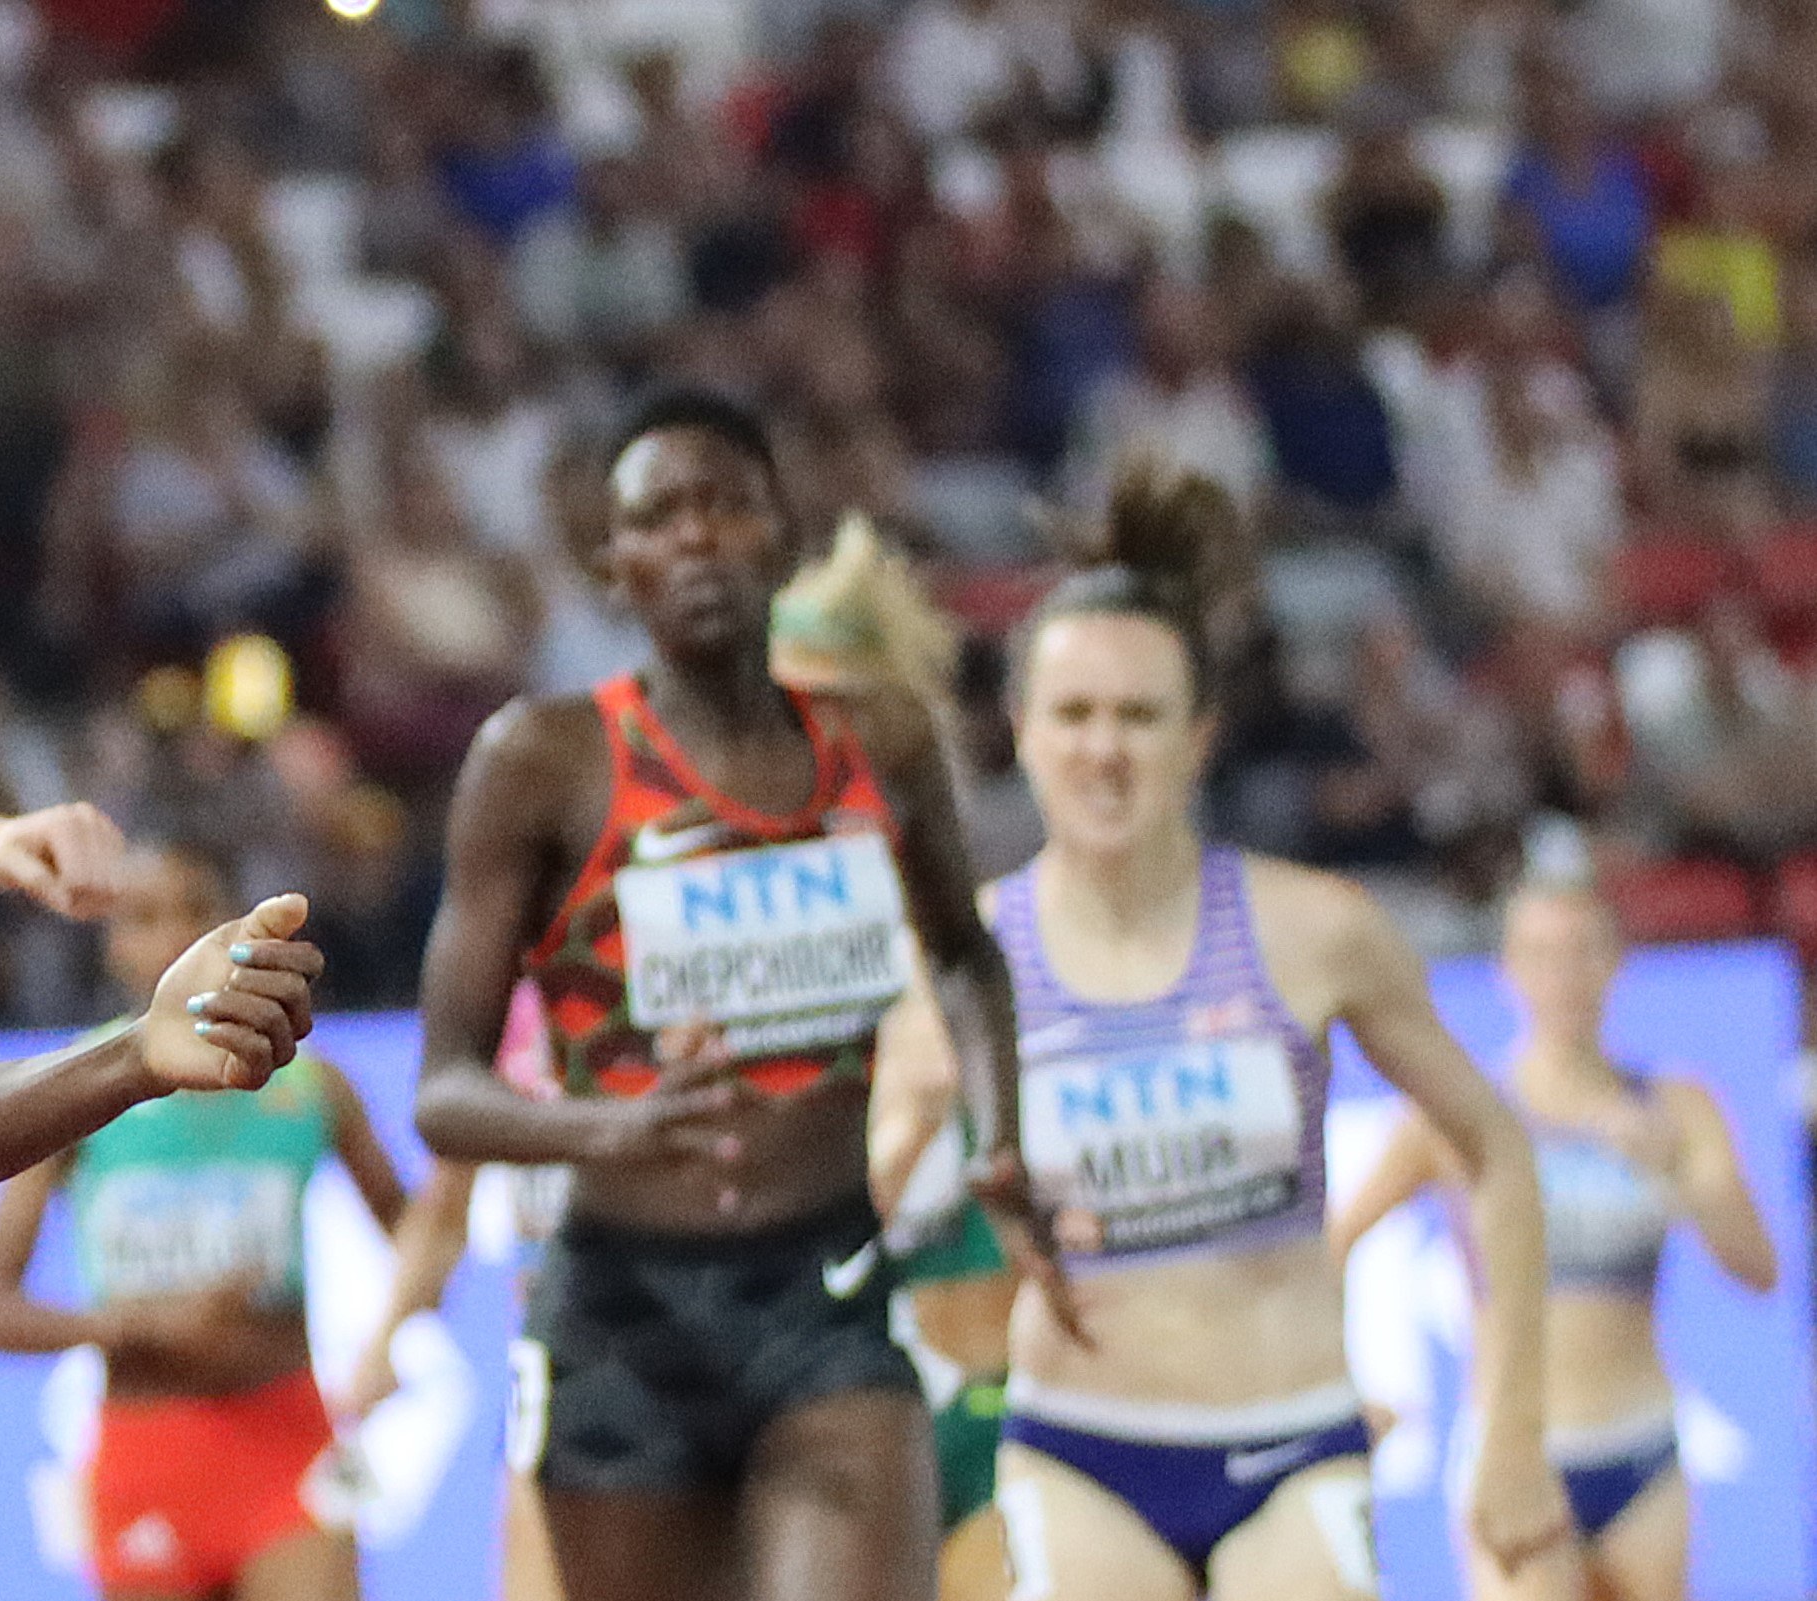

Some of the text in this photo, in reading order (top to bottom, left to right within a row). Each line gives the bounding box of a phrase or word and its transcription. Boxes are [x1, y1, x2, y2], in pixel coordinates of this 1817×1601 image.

[676, 850, 853, 930] NTN
[1058, 1046, 1233, 1125] NTN
[1077, 1125, 1236, 1190] MUIR
